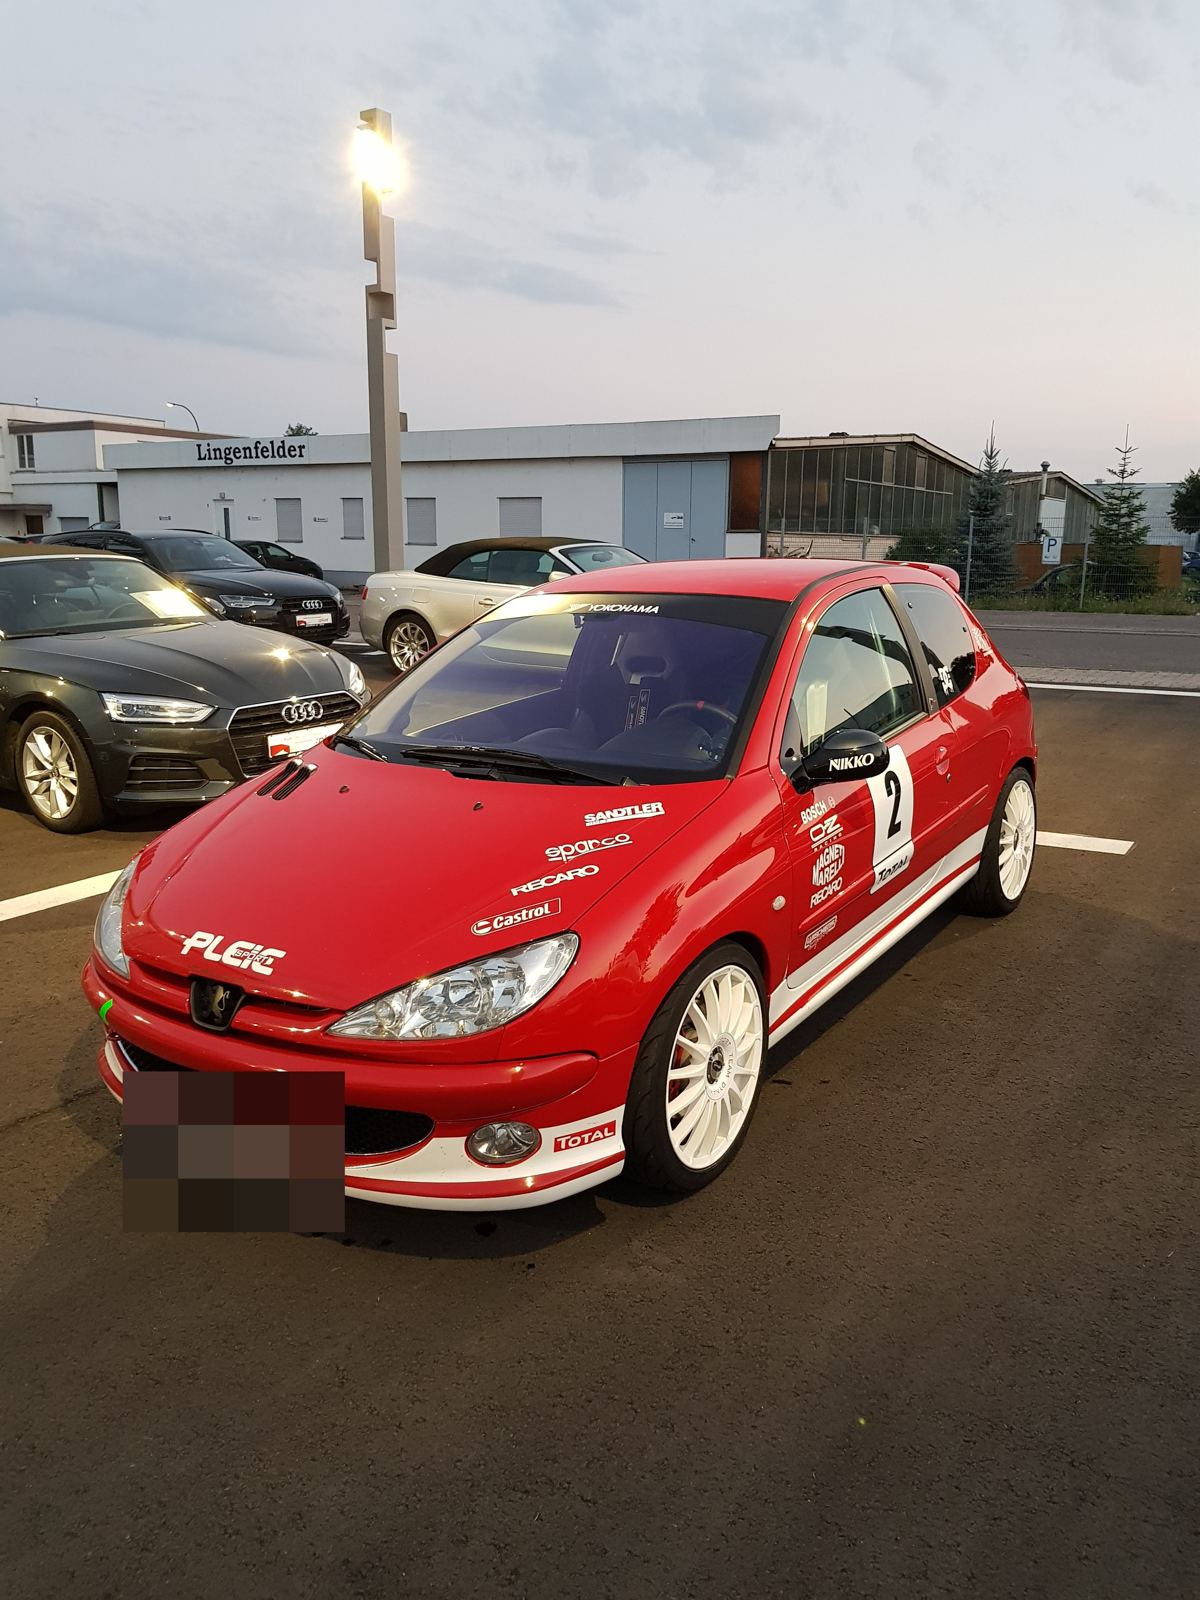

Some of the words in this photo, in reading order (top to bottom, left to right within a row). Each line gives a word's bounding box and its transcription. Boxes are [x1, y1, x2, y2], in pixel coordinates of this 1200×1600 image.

[196, 440, 306, 465] Lingenfelder
[1047, 538, 1057, 552] P
[588, 604, 660, 614] YOKOHAMA
[829, 752, 875, 772] NIKKO
[584, 801, 665, 825] SANDTLER
[801, 800, 828, 825] BOSCH
[884, 770, 902, 840] 2
[545, 833, 633, 863] sparco
[510, 864, 600, 896] RECARO
[810, 877, 843, 909] RECARO
[492, 902, 551, 930] Castrol
[556, 1127, 615, 1149] TOTAL
